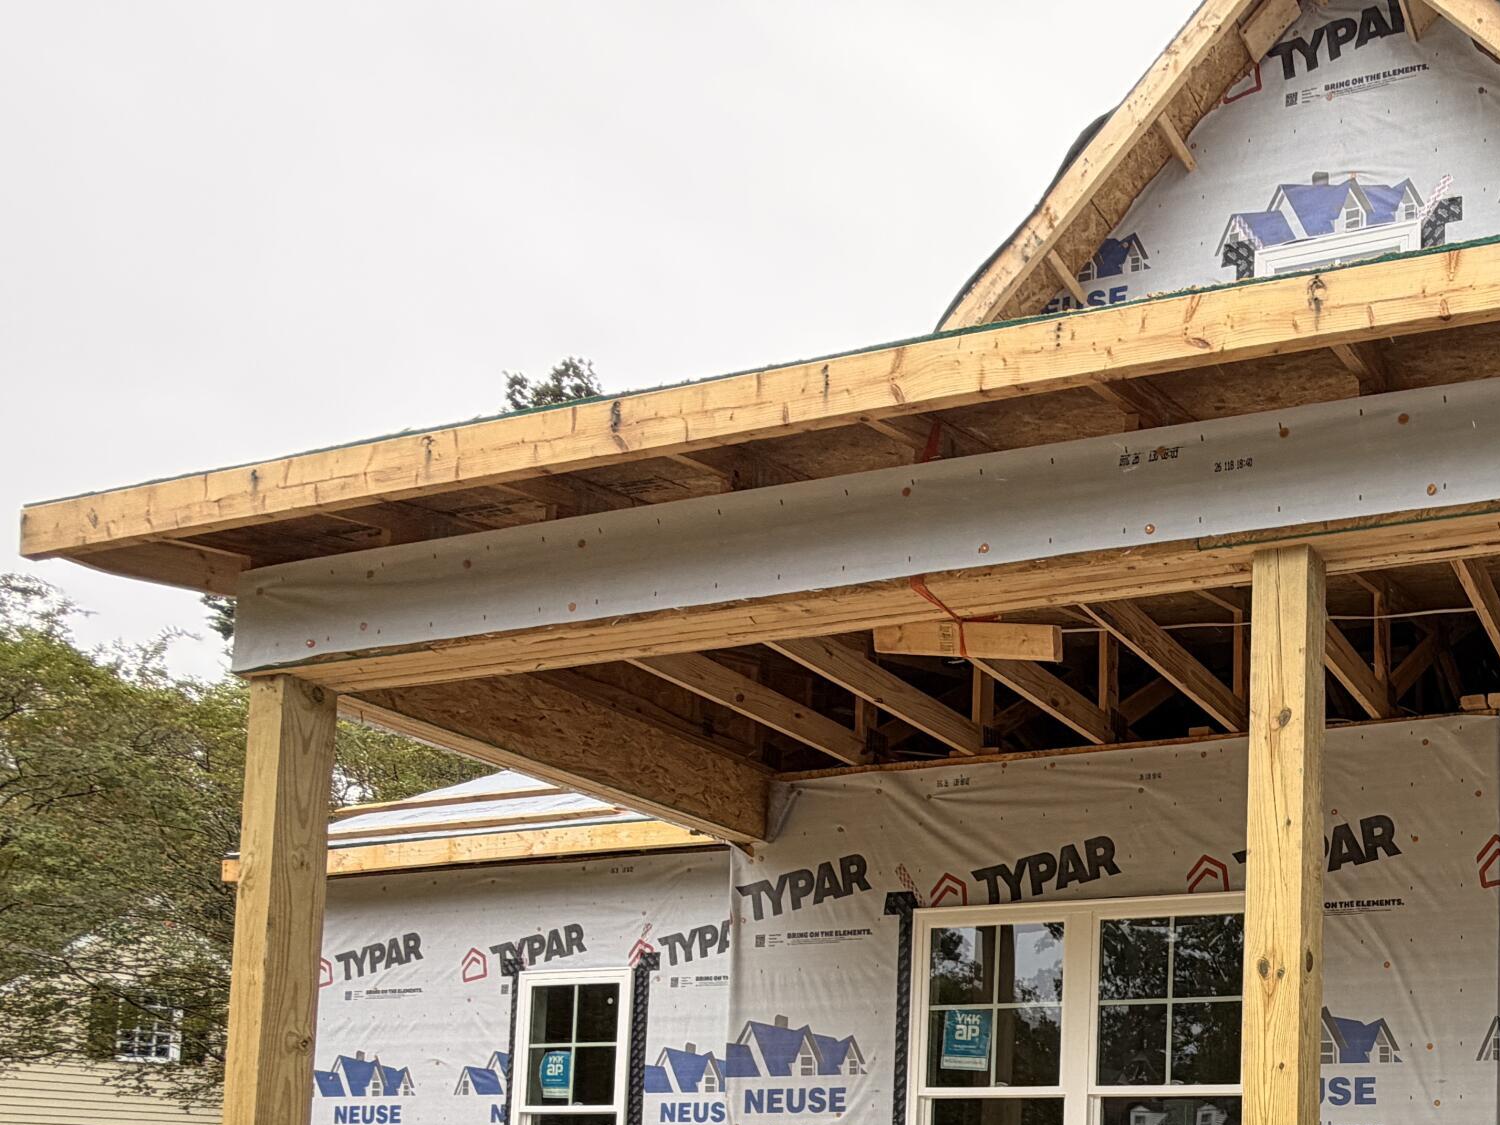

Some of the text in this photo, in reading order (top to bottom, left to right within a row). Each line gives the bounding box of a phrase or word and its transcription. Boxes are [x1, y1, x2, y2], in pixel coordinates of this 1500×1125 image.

[1324, 63, 1430, 91] BRING ON THE ELEMENTS.
[972, 835, 1122, 904] TYPAR
[735, 853, 873, 921] TYPAR
[1324, 898, 1405, 909] ON THE ELEMENTS.
[335, 932, 424, 981] TYPAR
[657, 920, 730, 966] TYPA
[334, 1105, 402, 1124] NEUSE
[660, 1102, 726, 1123] NEUS
[744, 1087, 847, 1114] NEUSE
